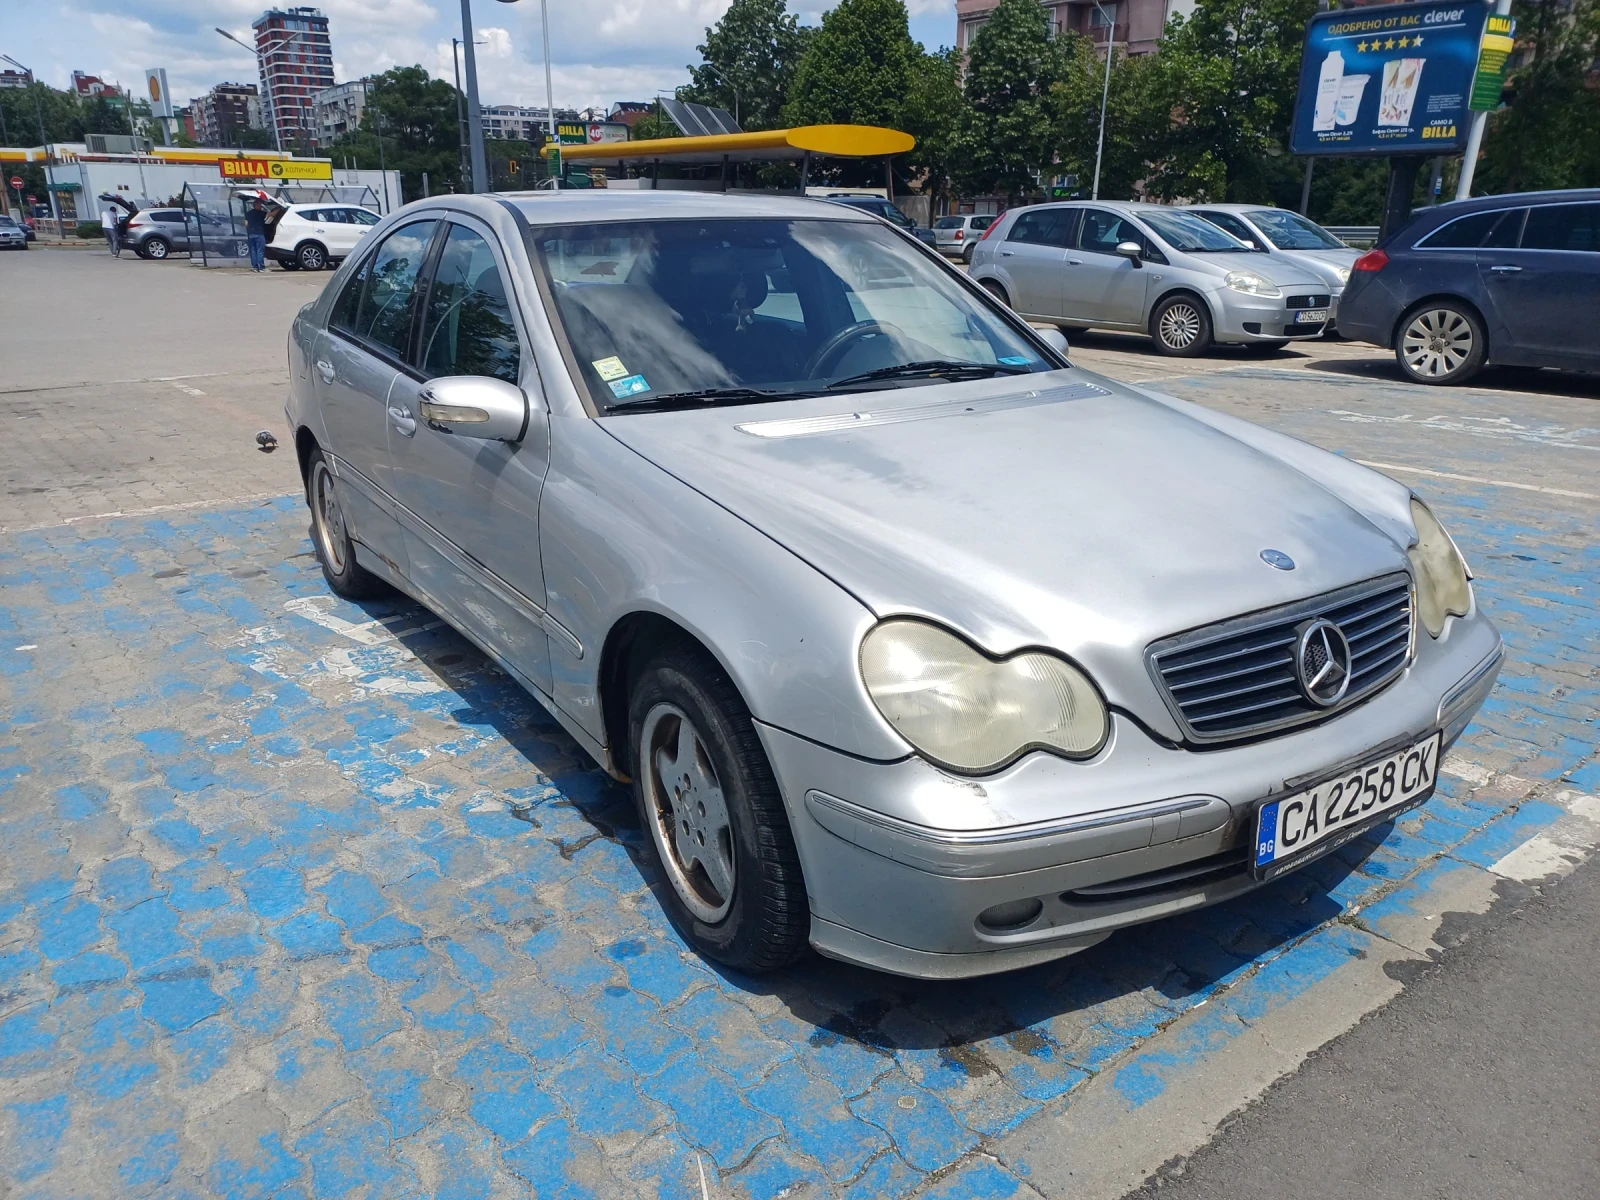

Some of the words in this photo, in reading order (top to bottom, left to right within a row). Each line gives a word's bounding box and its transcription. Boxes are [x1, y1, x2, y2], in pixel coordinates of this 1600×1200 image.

[1328, 20, 1381, 35] ОДОБРЕНО
[1384, 18, 1398, 28] ОТ
[1400, 15, 1420, 26] ВАС
[1424, 9, 1464, 24] clever
[558, 125, 584, 136] BILLA
[1422, 125, 1456, 139] BILLA
[223, 161, 266, 176] BILLA
[1281, 793, 1318, 847] CA
[1324, 761, 1396, 829] 2258
[1401, 742, 1434, 794] CK
[1259, 839, 1274, 857] BG
